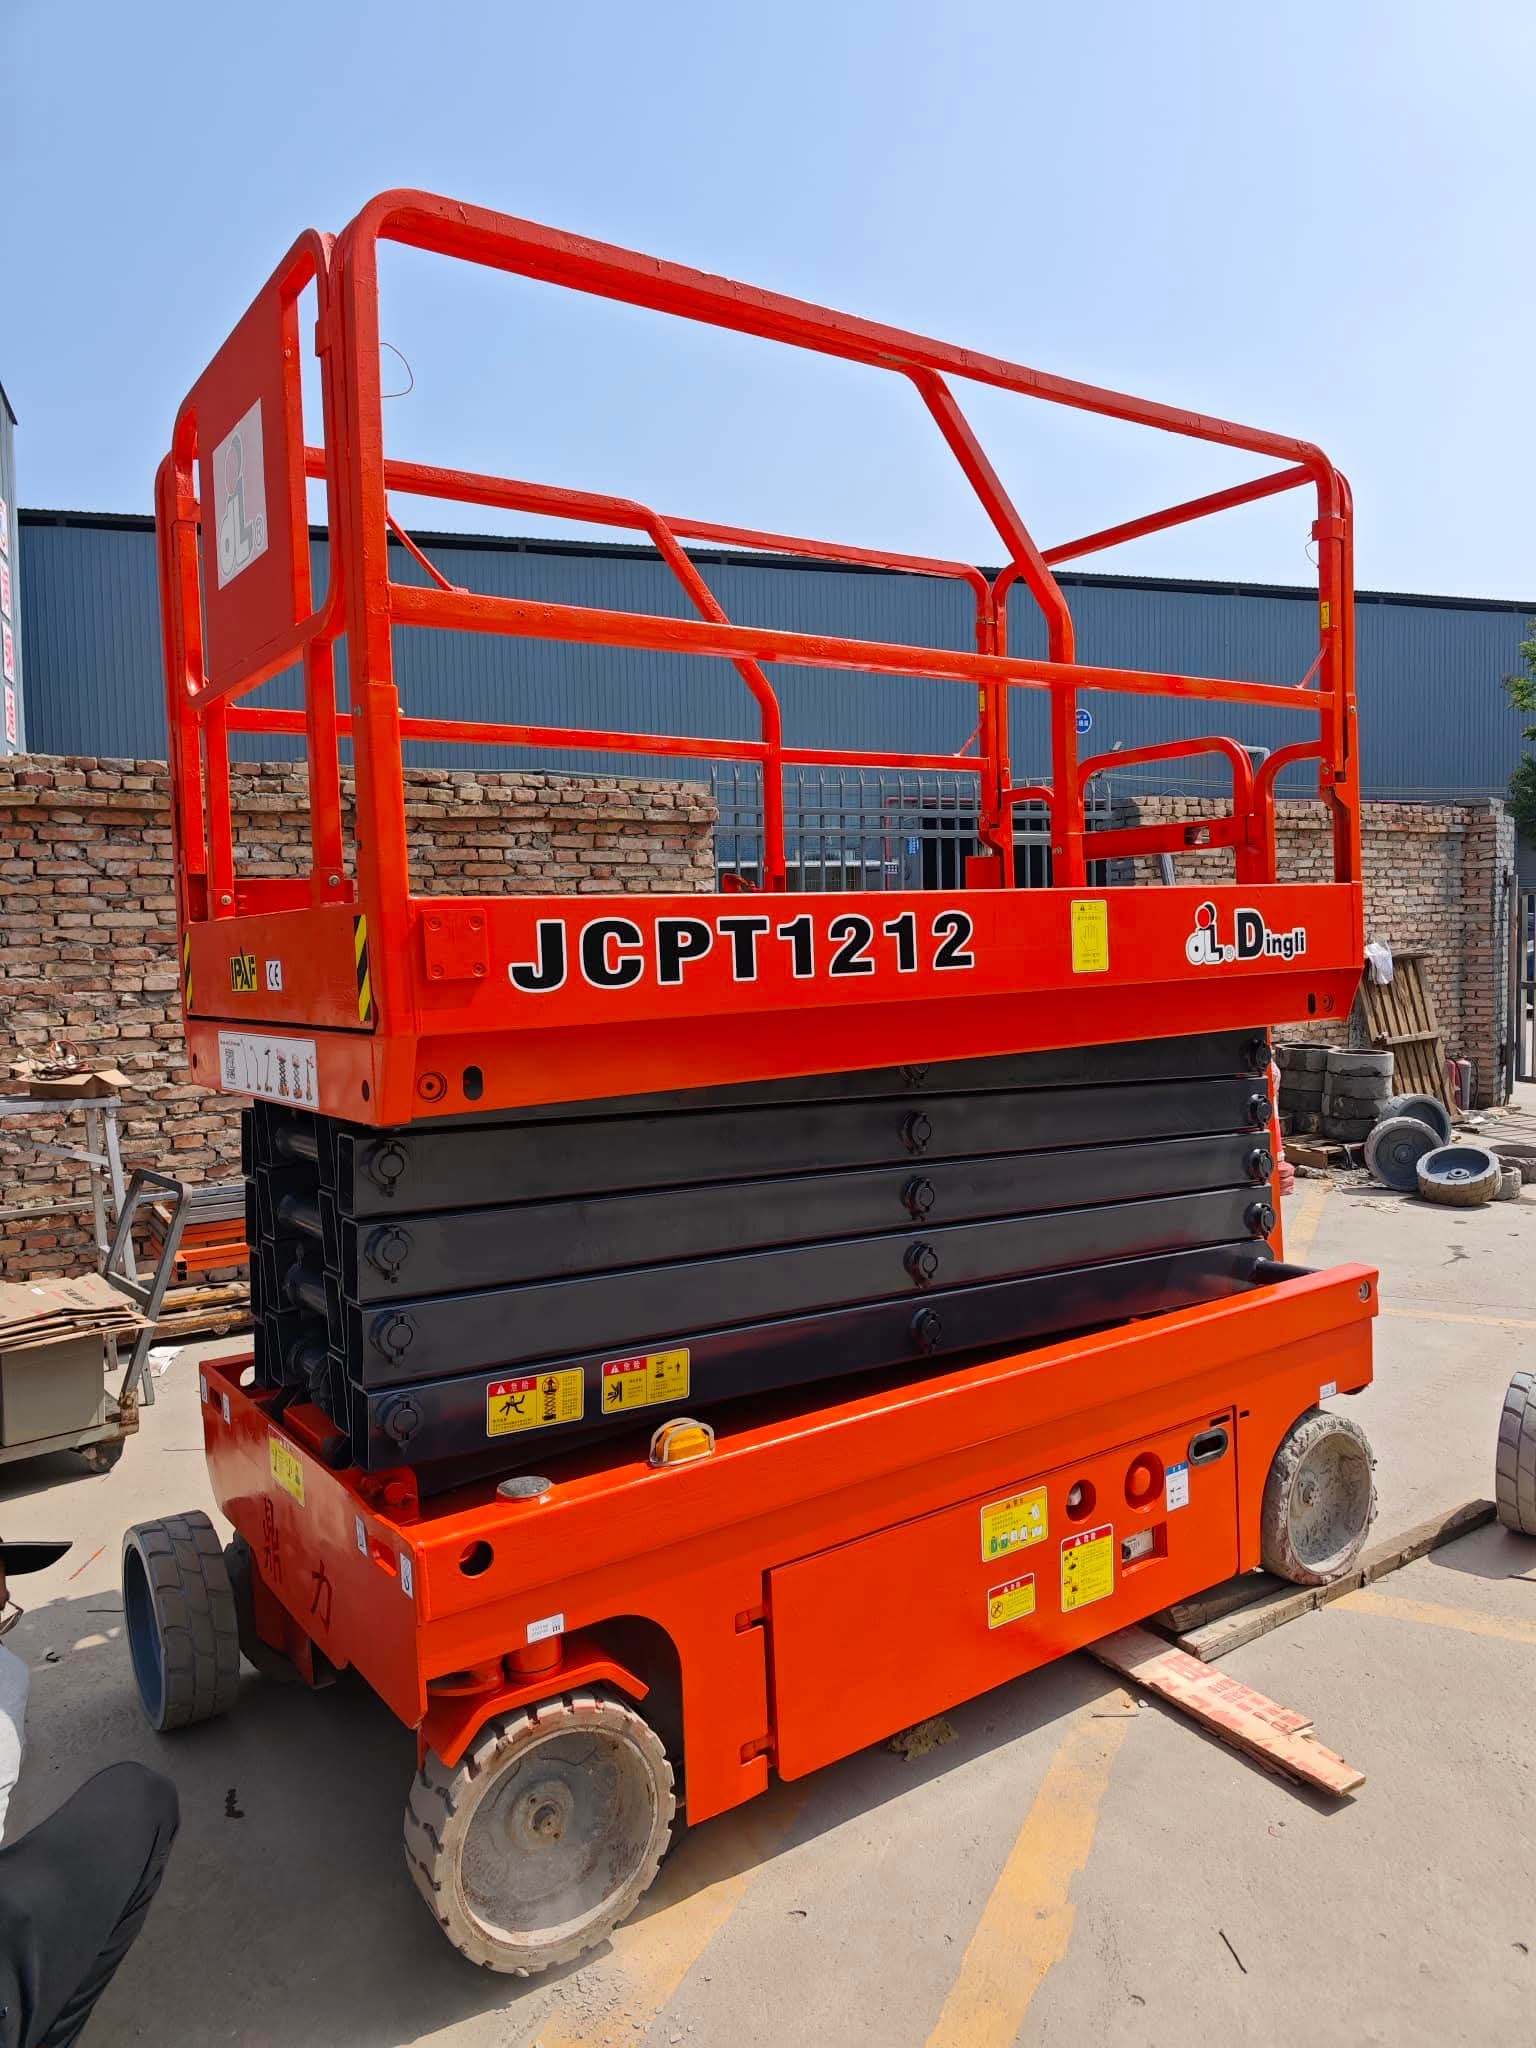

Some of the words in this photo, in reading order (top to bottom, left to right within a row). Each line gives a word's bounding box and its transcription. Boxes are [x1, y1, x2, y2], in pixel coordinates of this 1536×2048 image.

[230, 945, 256, 989] IPAF
[509, 910, 974, 992] JCPT1212
[268, 963, 280, 987] CE
